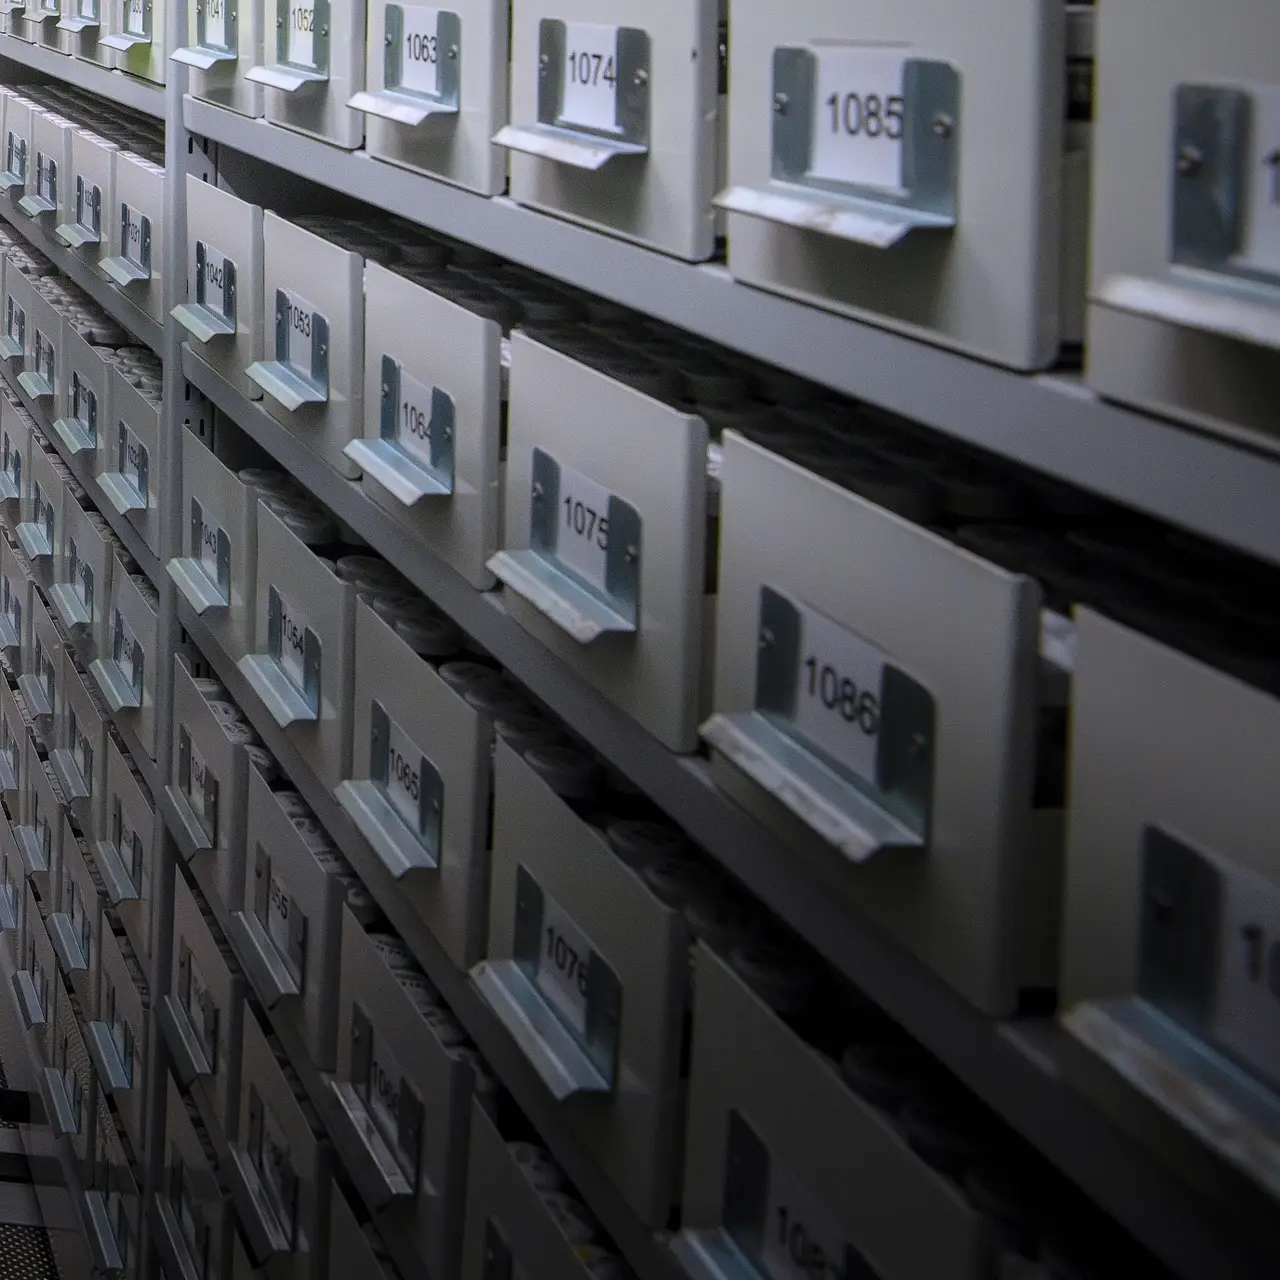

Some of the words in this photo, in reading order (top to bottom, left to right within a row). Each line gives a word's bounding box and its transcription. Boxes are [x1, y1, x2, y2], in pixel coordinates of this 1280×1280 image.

[291, 6, 315, 32] 1052
[406, 32, 438, 64] 1063
[568, 49, 616, 87] 1074
[825, 91, 905, 140] 1085
[564, 496, 610, 552] 1075
[806, 655, 880, 737] 1086
[389, 748, 420, 802] 1065
[545, 928, 588, 996] 1076
